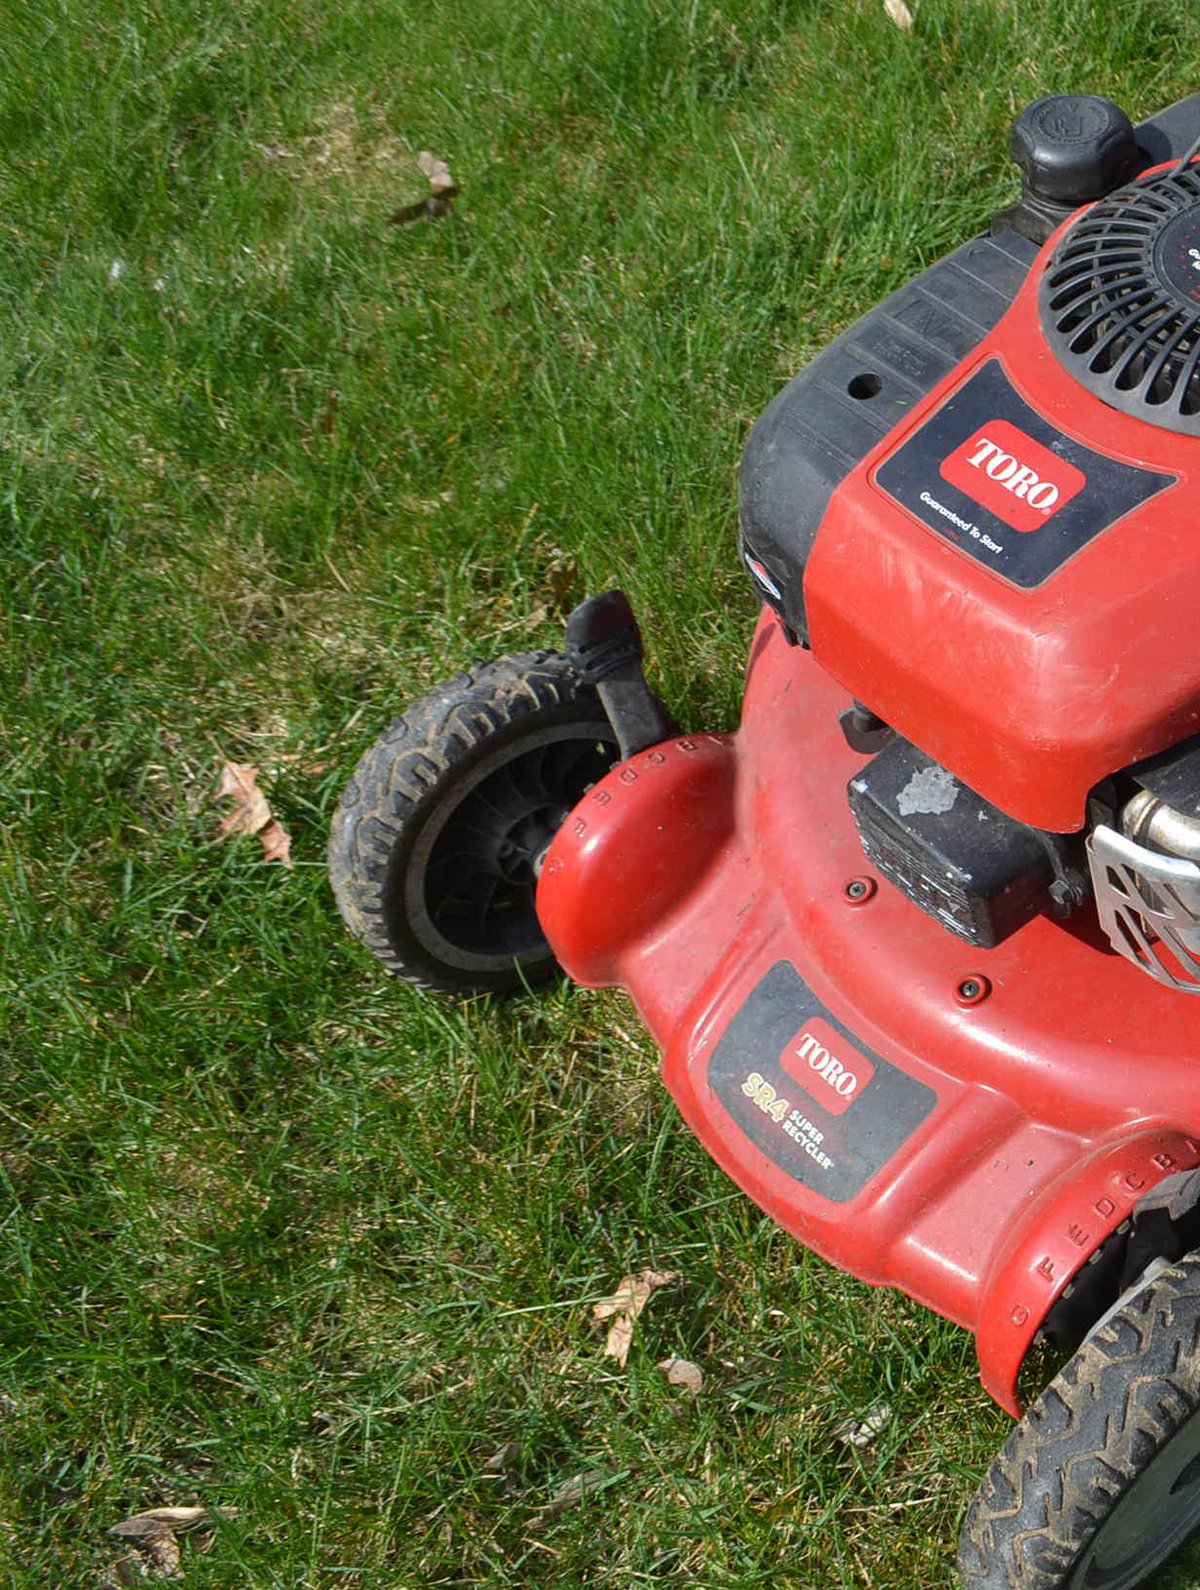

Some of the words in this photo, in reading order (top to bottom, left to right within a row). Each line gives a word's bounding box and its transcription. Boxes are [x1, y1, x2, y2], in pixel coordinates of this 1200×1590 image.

[920, 491, 972, 531] Guaranteed
[969, 526, 981, 538] To
[980, 534, 1003, 554] Start
[741, 1072, 790, 1123] SR4
[789, 1109, 824, 1145] SUPER
